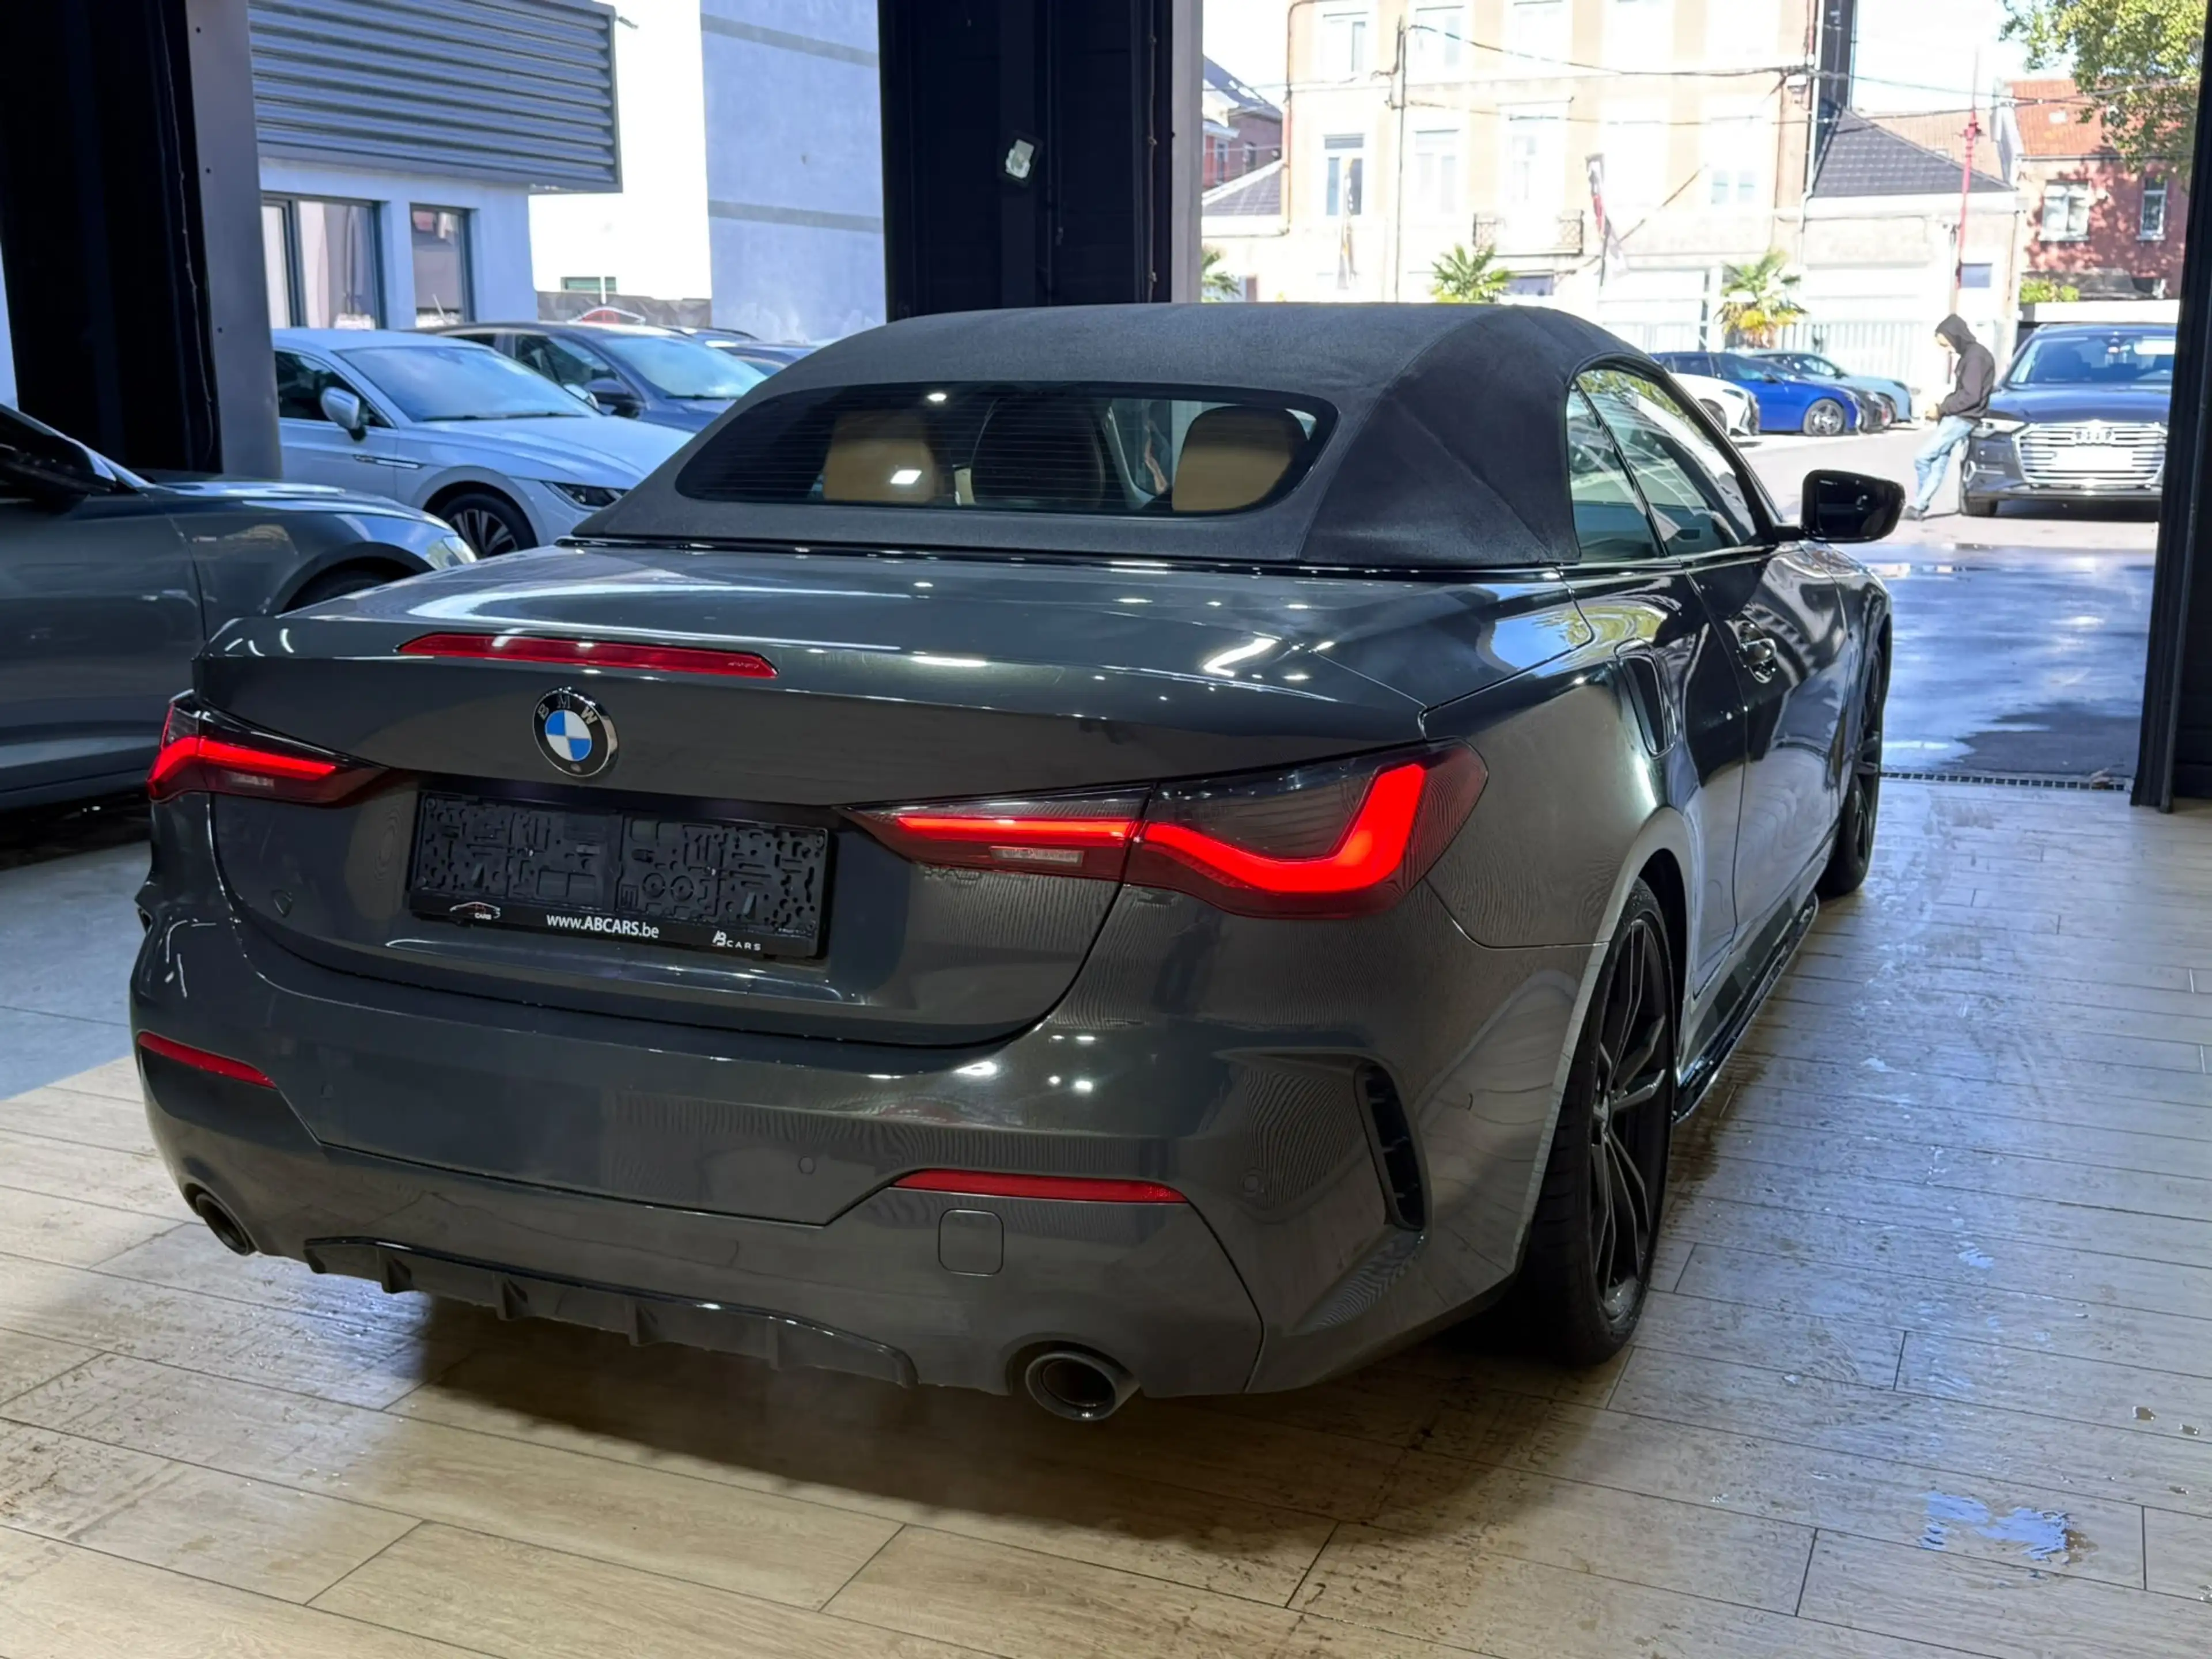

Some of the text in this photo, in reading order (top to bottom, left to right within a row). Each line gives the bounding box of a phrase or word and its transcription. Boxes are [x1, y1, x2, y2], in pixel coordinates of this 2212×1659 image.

[537, 693, 599, 725] BMW
[546, 914, 660, 938] www.ABCARS.be
[726, 940, 762, 951] CARS
